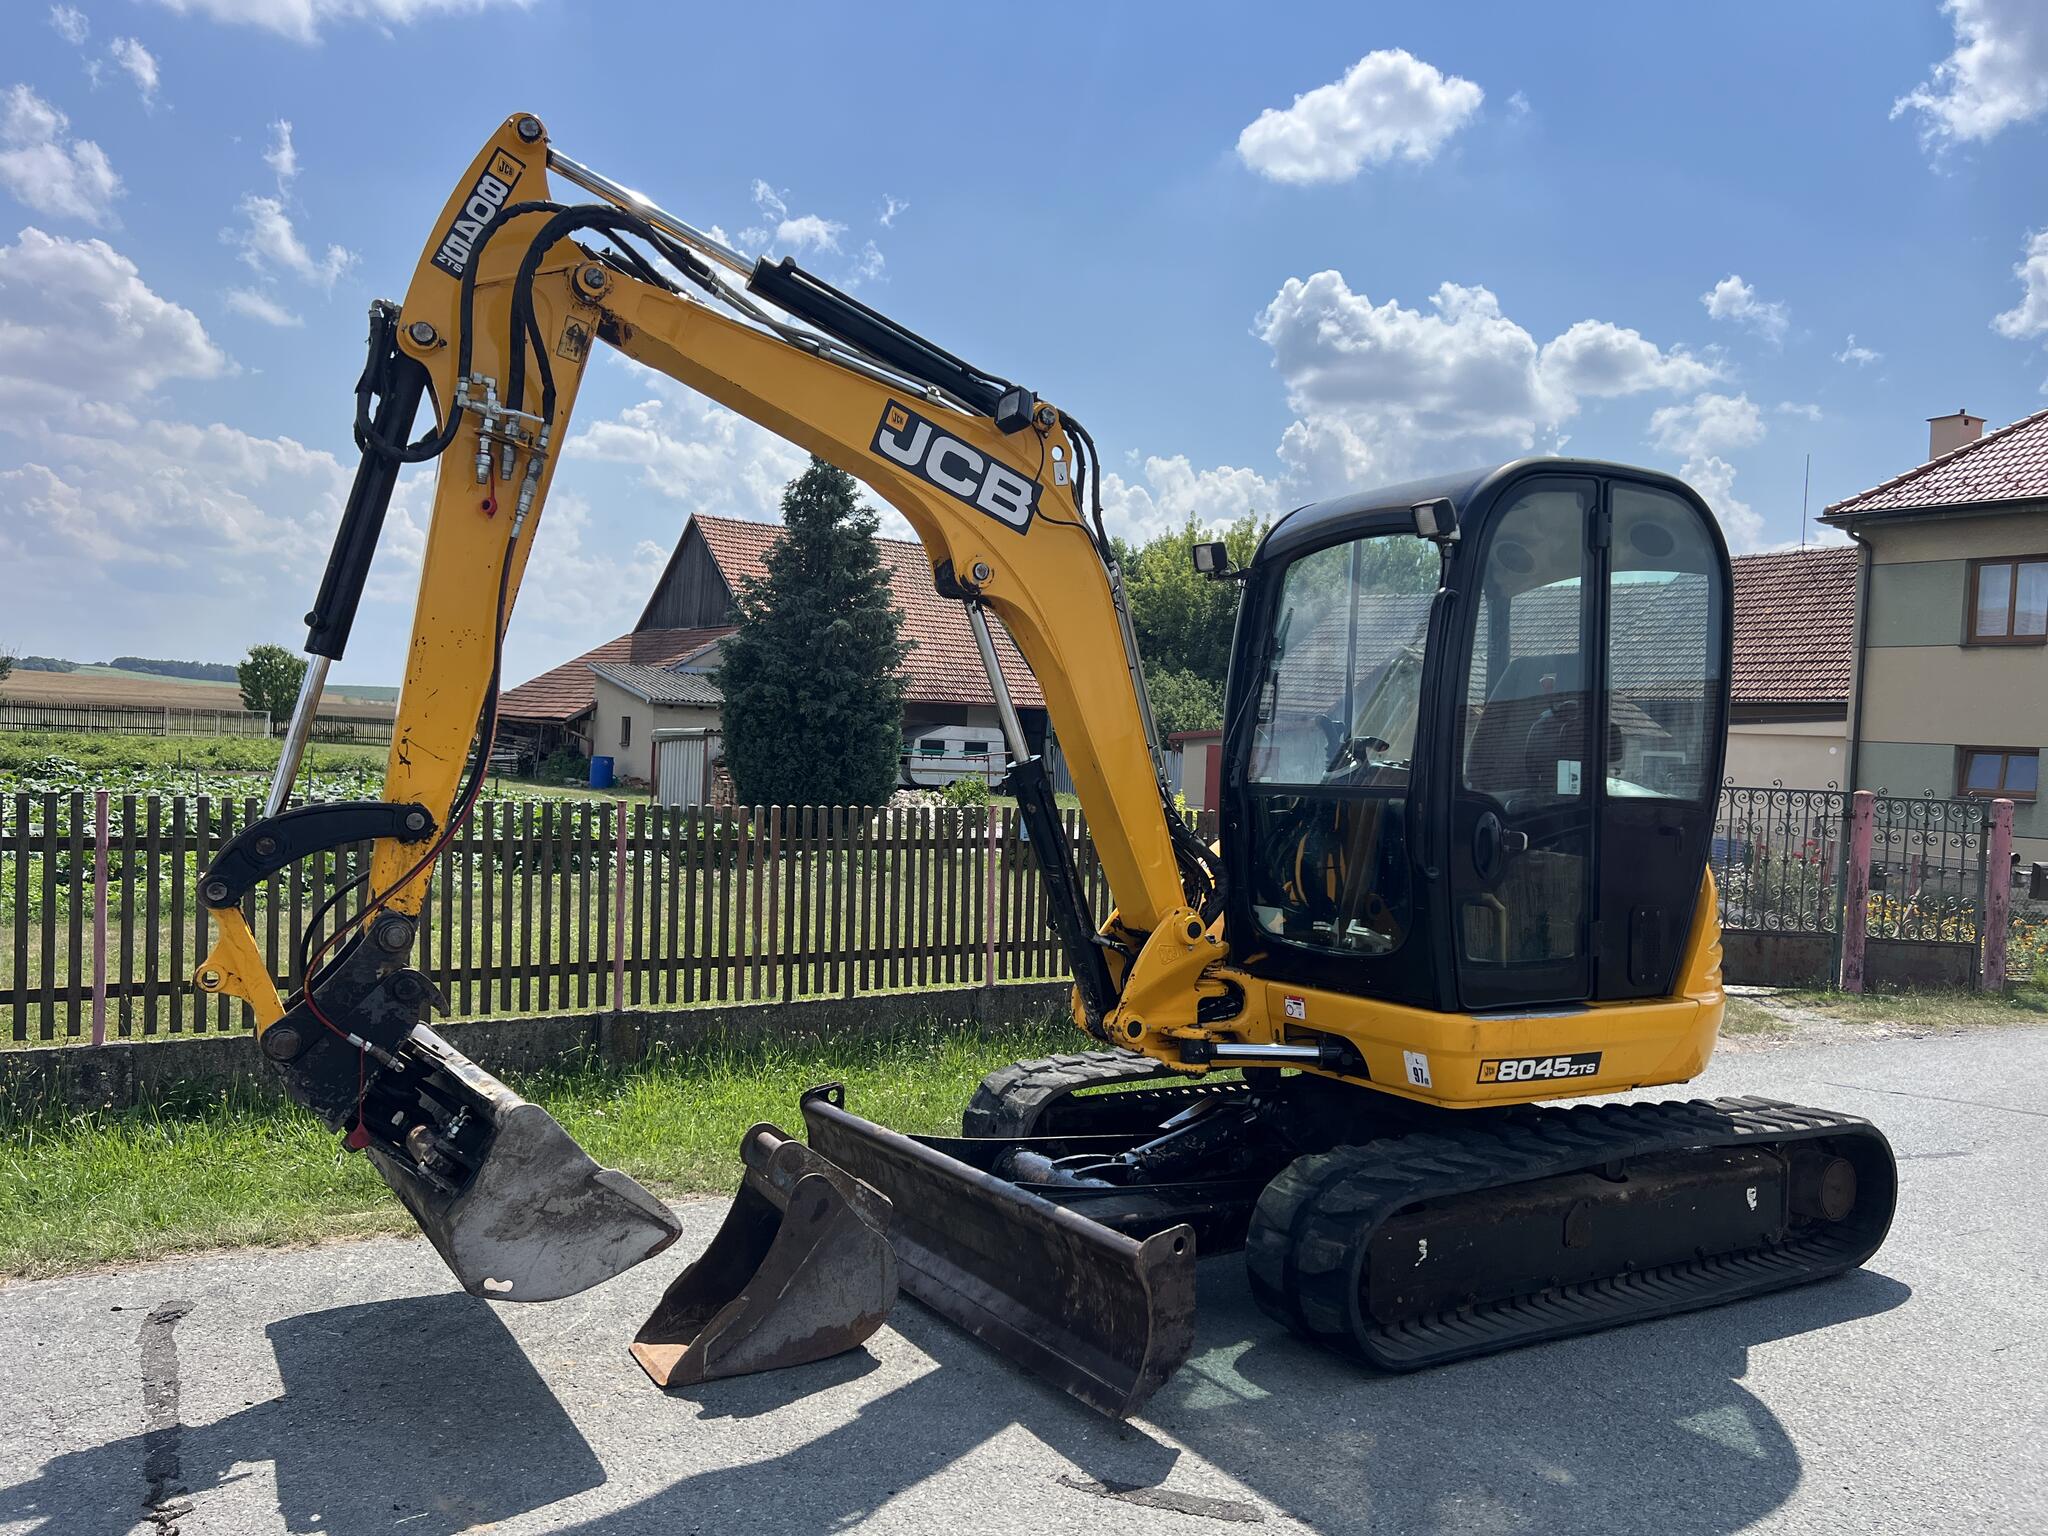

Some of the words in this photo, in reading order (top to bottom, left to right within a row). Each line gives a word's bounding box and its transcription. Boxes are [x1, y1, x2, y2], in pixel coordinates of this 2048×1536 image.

[436, 252, 464, 274] ZTS
[442, 174, 509, 265] 8045
[878, 421, 1034, 526] JCB
